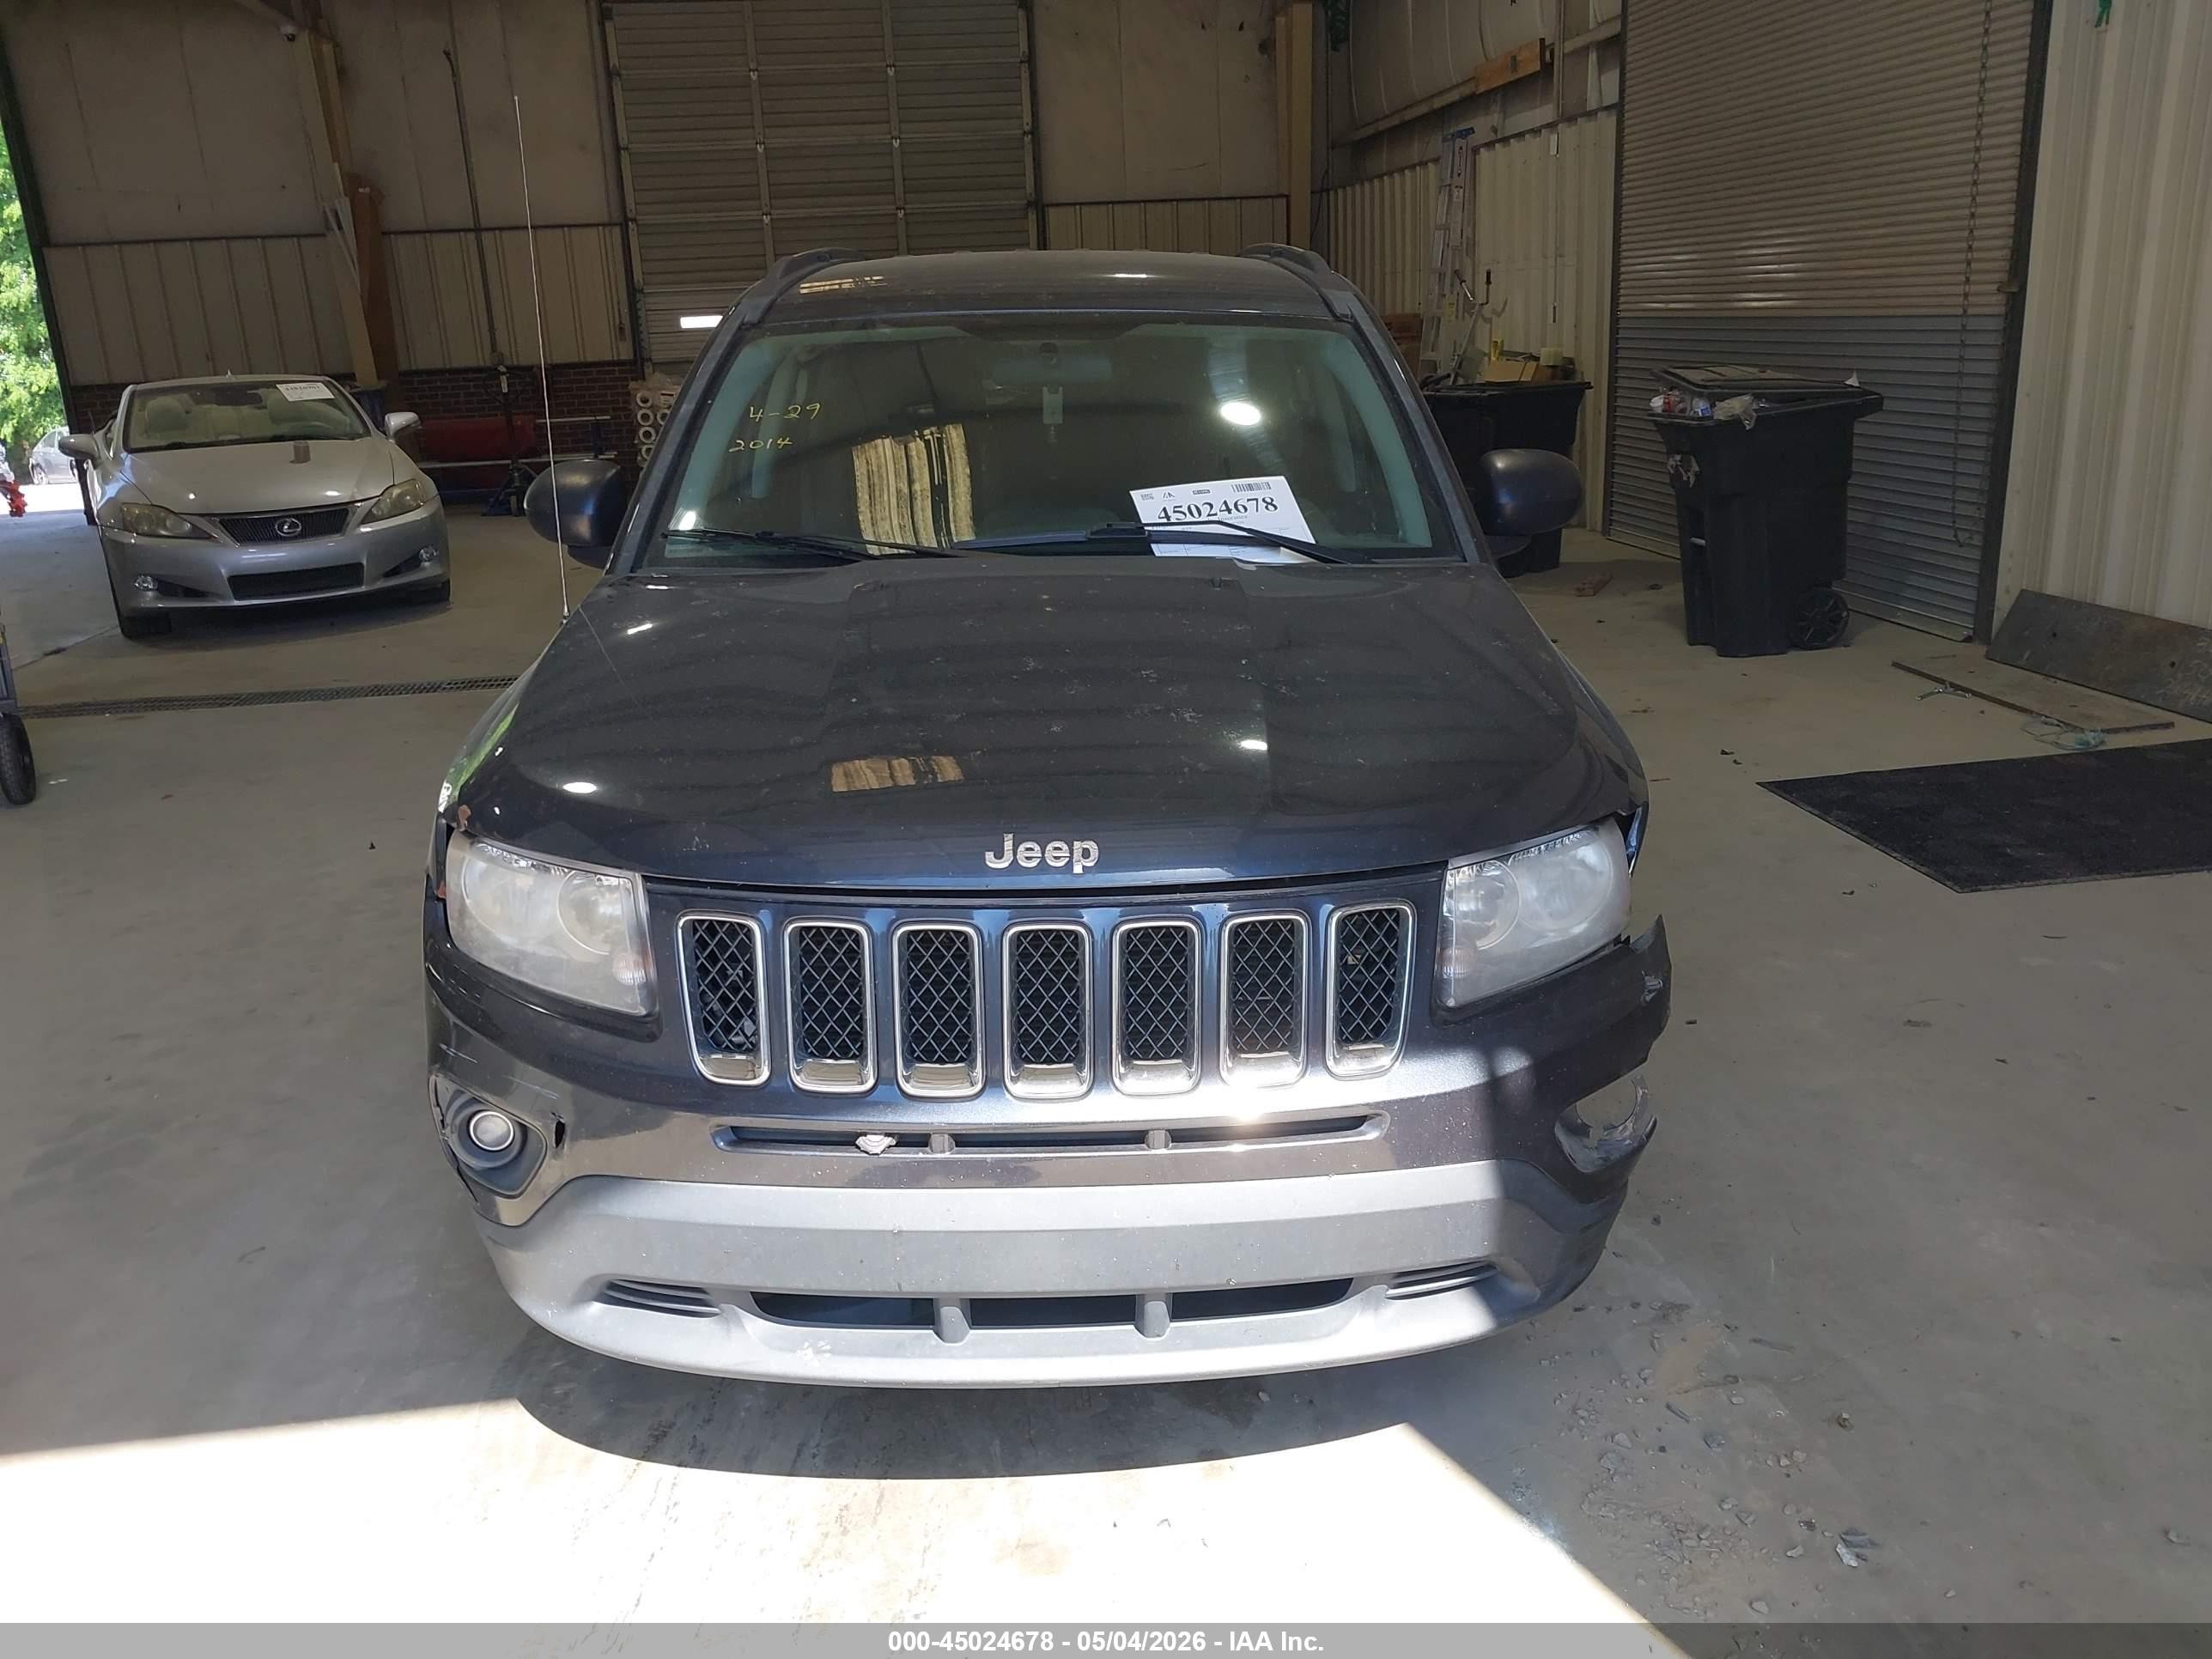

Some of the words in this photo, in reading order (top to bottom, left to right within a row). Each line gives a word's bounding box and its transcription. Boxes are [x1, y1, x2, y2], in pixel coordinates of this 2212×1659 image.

[749, 403, 821, 422] 4-29
[728, 436, 793, 453] 2014
[1157, 495, 1279, 523] 45024678
[985, 833, 1099, 874] Jeep
